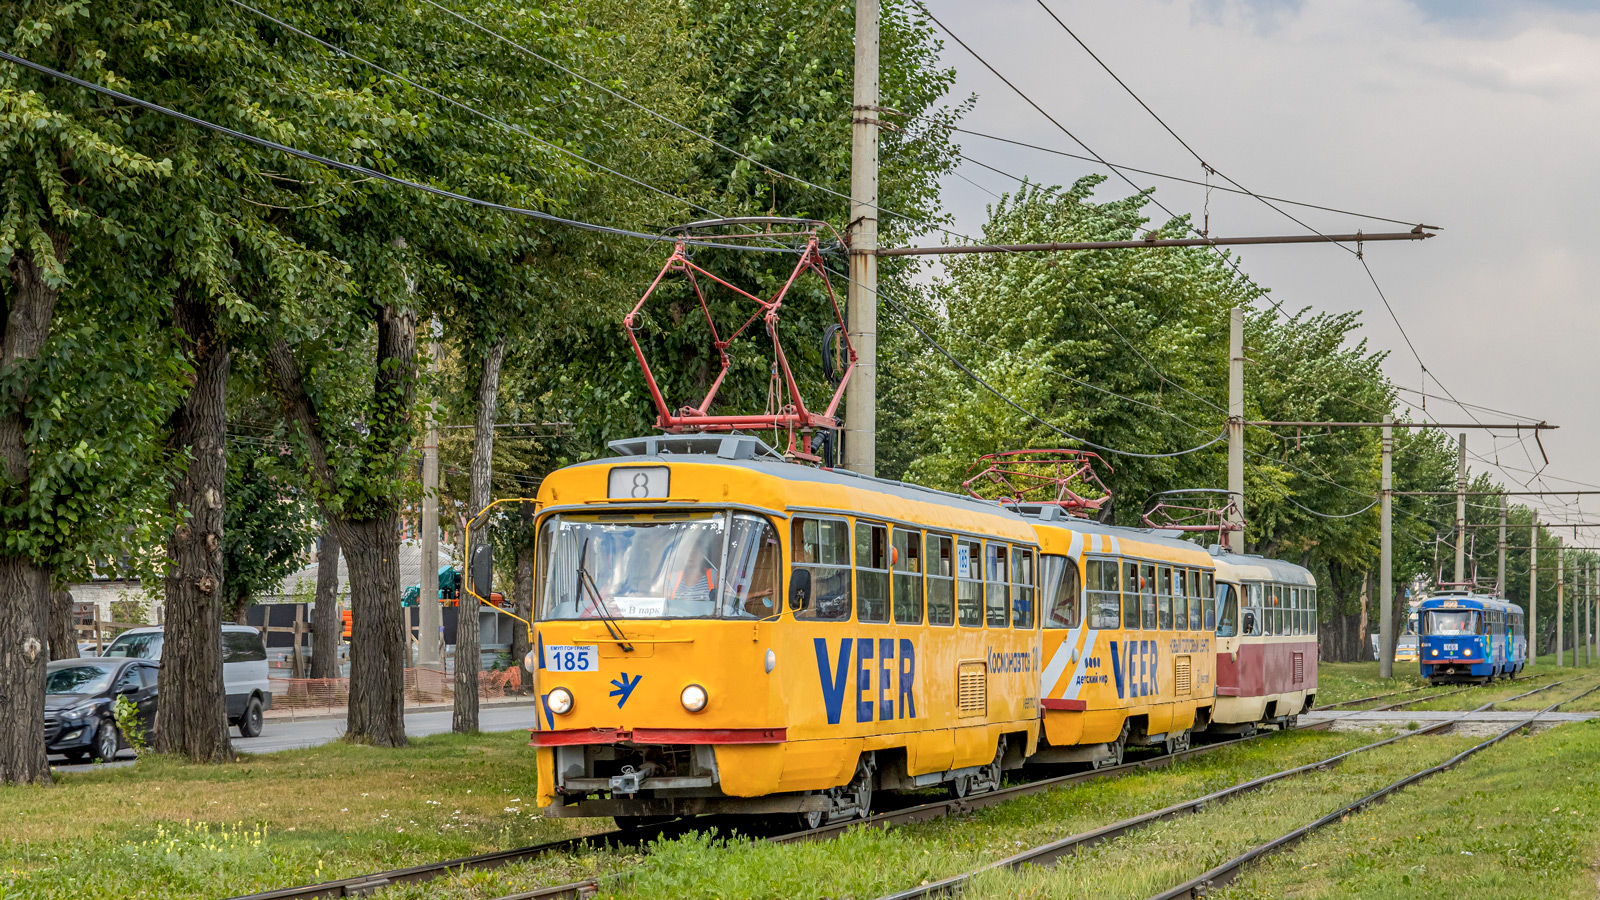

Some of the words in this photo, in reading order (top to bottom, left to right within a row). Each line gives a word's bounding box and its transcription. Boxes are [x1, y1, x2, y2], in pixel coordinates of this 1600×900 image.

[631, 472, 649, 498] 8
[629, 606, 636, 614] В
[638, 607, 661, 616] парк
[553, 651, 590, 671] 185
[988, 646, 1030, 673] Космонавтов
[1110, 640, 1159, 699] VEER
[813, 637, 917, 725] VEER
